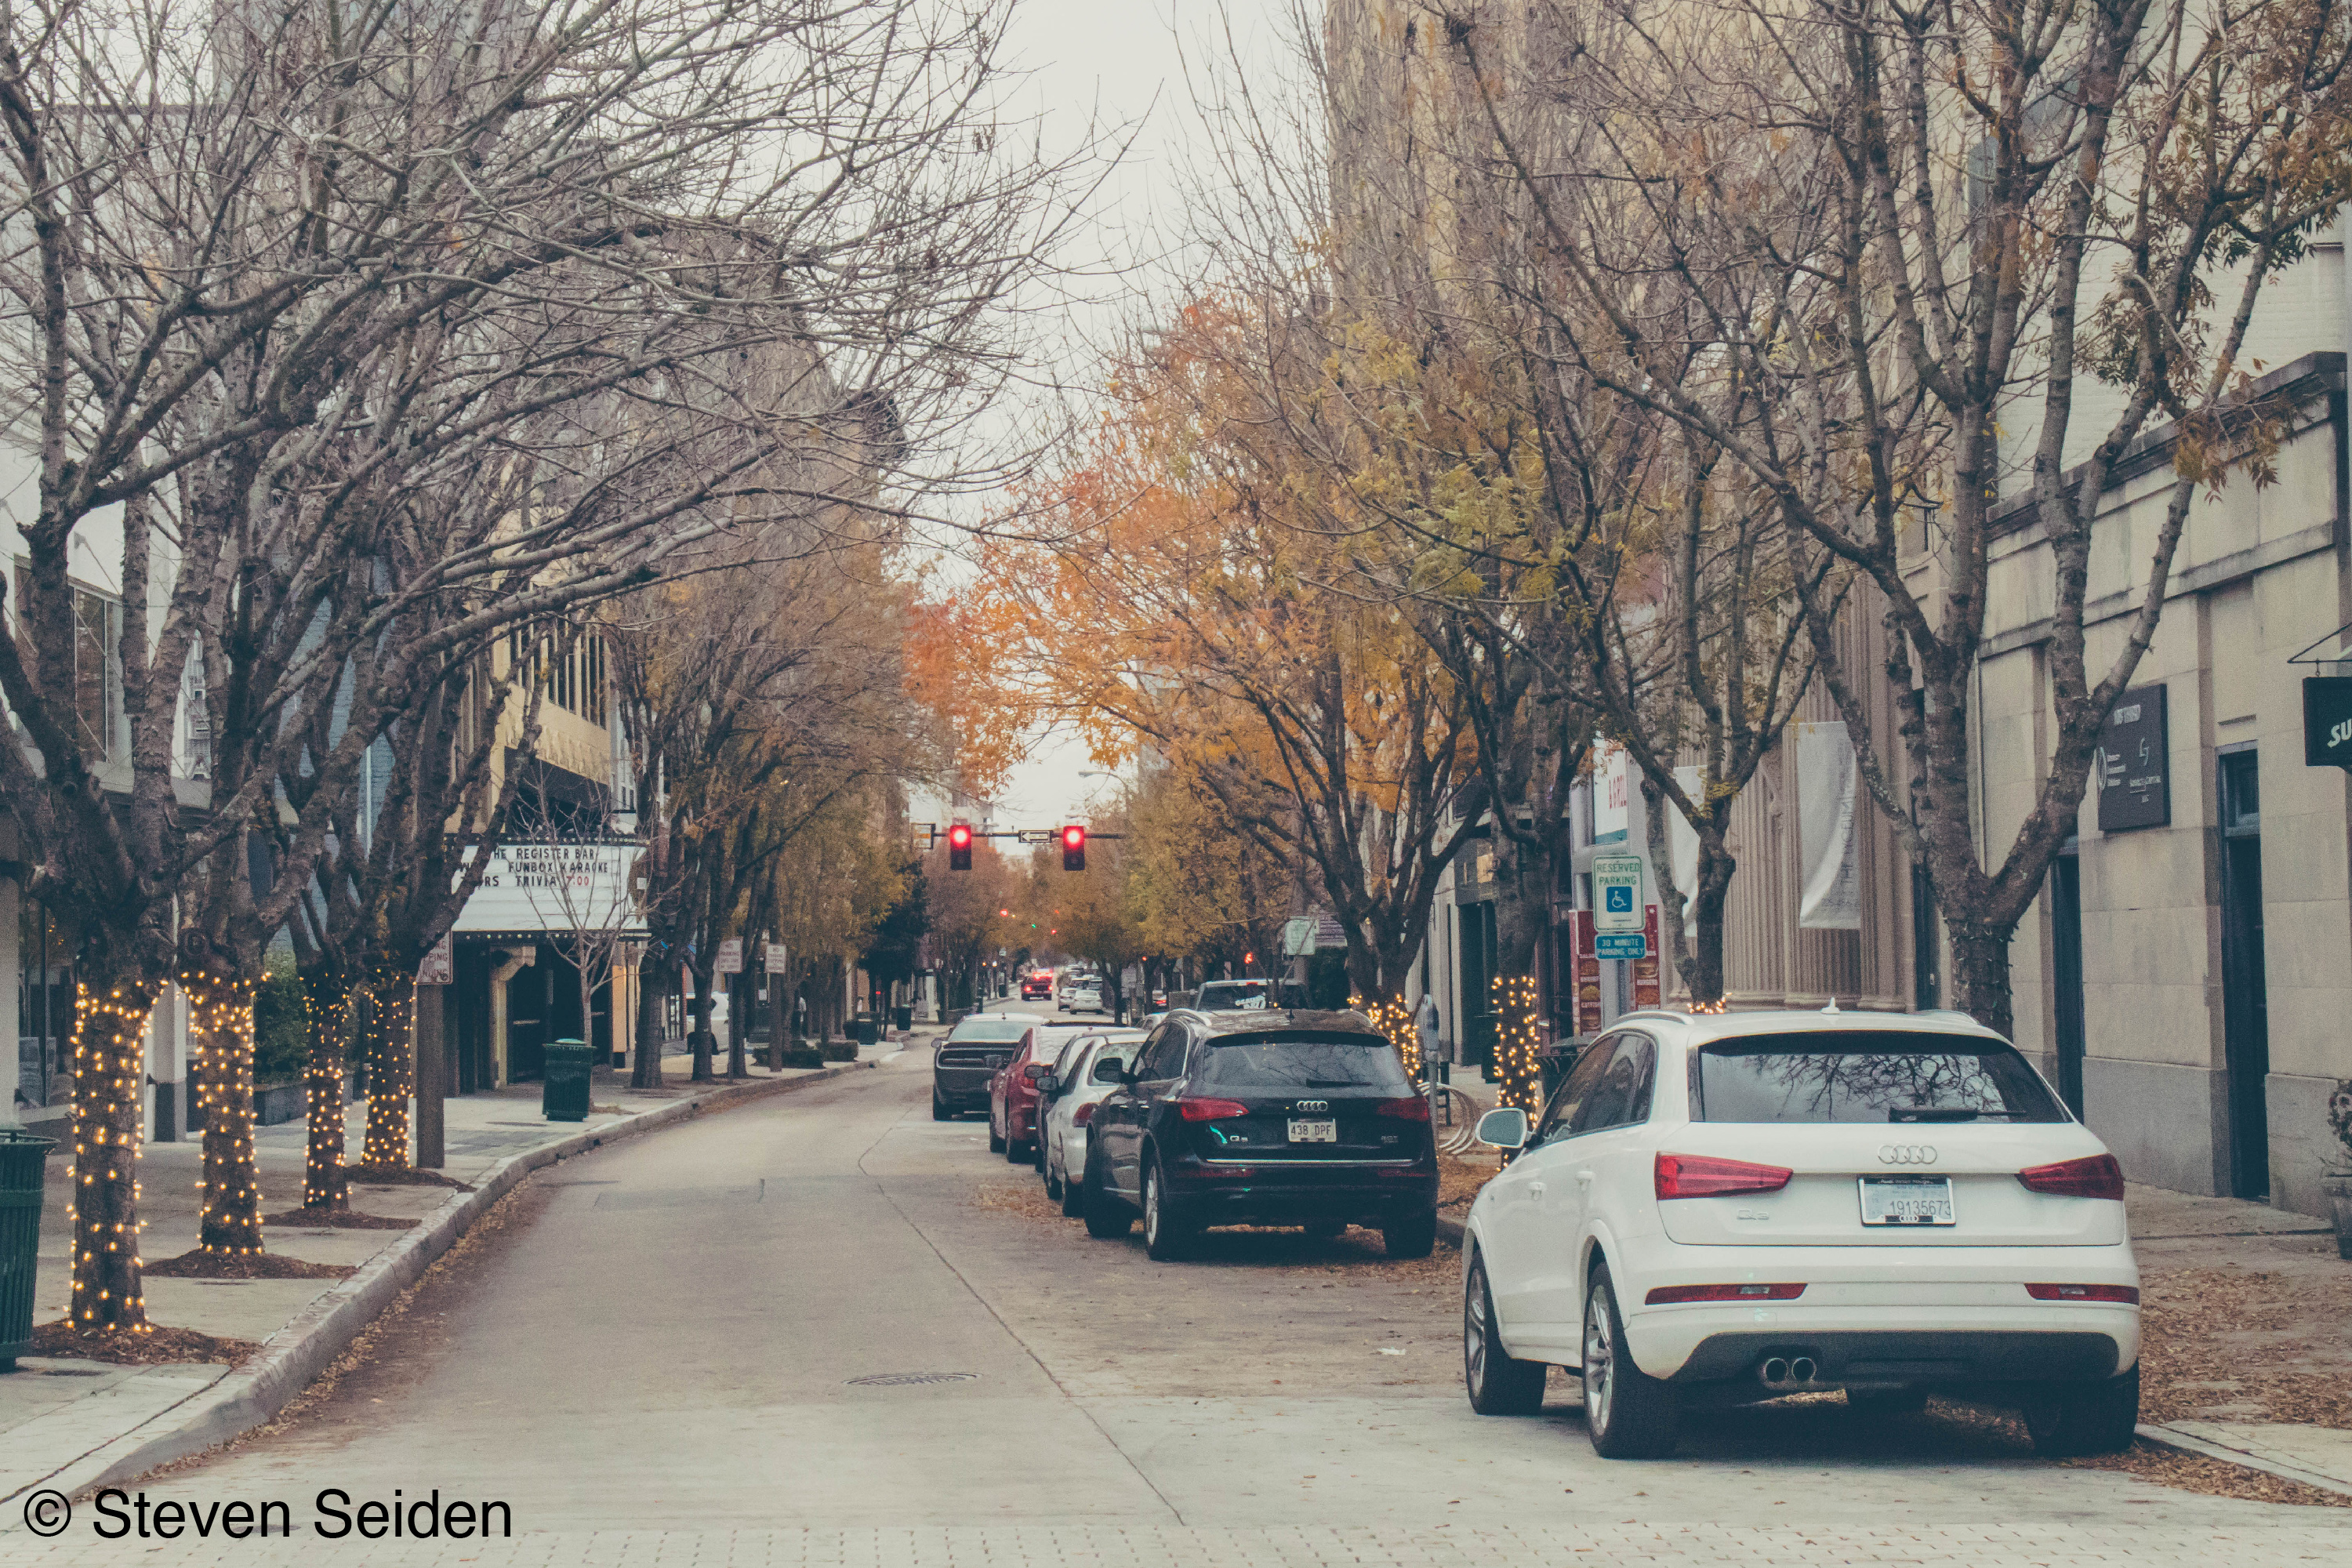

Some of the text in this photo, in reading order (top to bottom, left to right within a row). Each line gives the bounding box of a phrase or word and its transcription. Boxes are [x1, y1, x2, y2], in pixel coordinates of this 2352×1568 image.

[494, 848, 595, 859] HE REGISTER BAR
[508, 863, 608, 873] FUNBOX KARAOKE
[1596, 863, 1640, 873] RESERVED
[516, 876, 557, 887] TRIVIA
[566, 875, 590, 886] 7:00
[1599, 876, 1637, 886] PARKING
[1290, 1124, 1331, 1135] 438 DPF
[1889, 1200, 1951, 1216] 19135673
